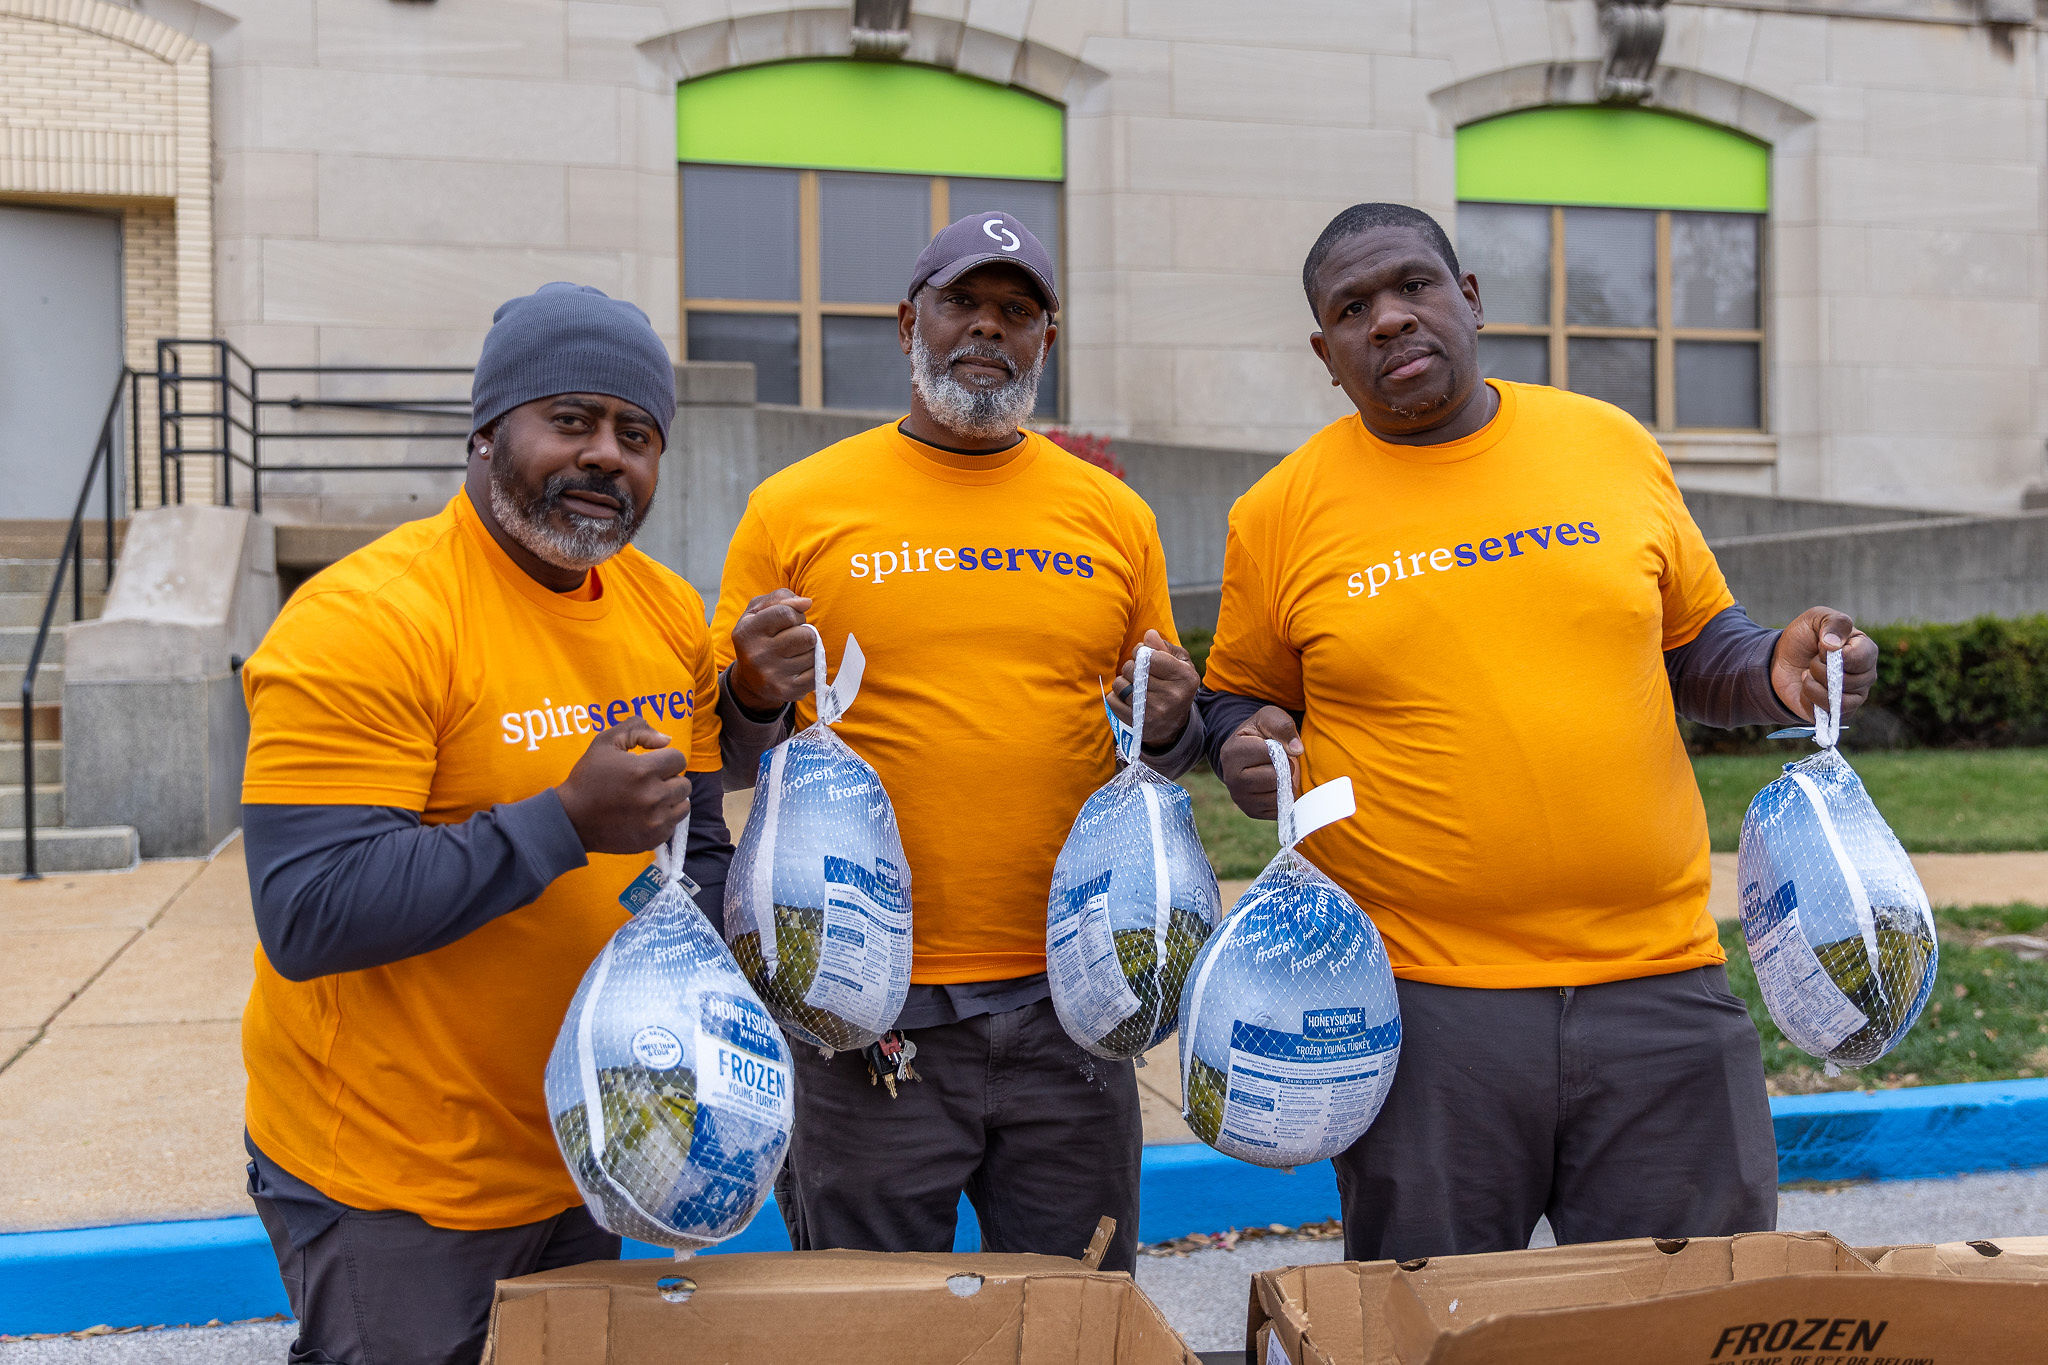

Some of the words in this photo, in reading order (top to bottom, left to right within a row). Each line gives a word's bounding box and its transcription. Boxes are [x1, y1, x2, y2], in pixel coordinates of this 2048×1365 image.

[850, 541, 1095, 584] spireserves
[1346, 520, 1601, 599] spireserves
[501, 688, 694, 751] spireserves
[828, 783, 871, 802] frozen
[1290, 941, 1332, 975] frozen
[1329, 932, 1364, 977] frozen
[739, 1027, 769, 1048] WHITE
[1308, 1012, 1362, 1027] HONEYSUCKLE
[1296, 1045, 1322, 1056] FROZEN
[1323, 1044, 1347, 1055] YOUNG
[718, 1048, 787, 1100] FROZEN
[728, 1082, 754, 1101] YOUNG
[755, 1092, 781, 1111] TURKEY
[1710, 1318, 1889, 1359] FROZEN
